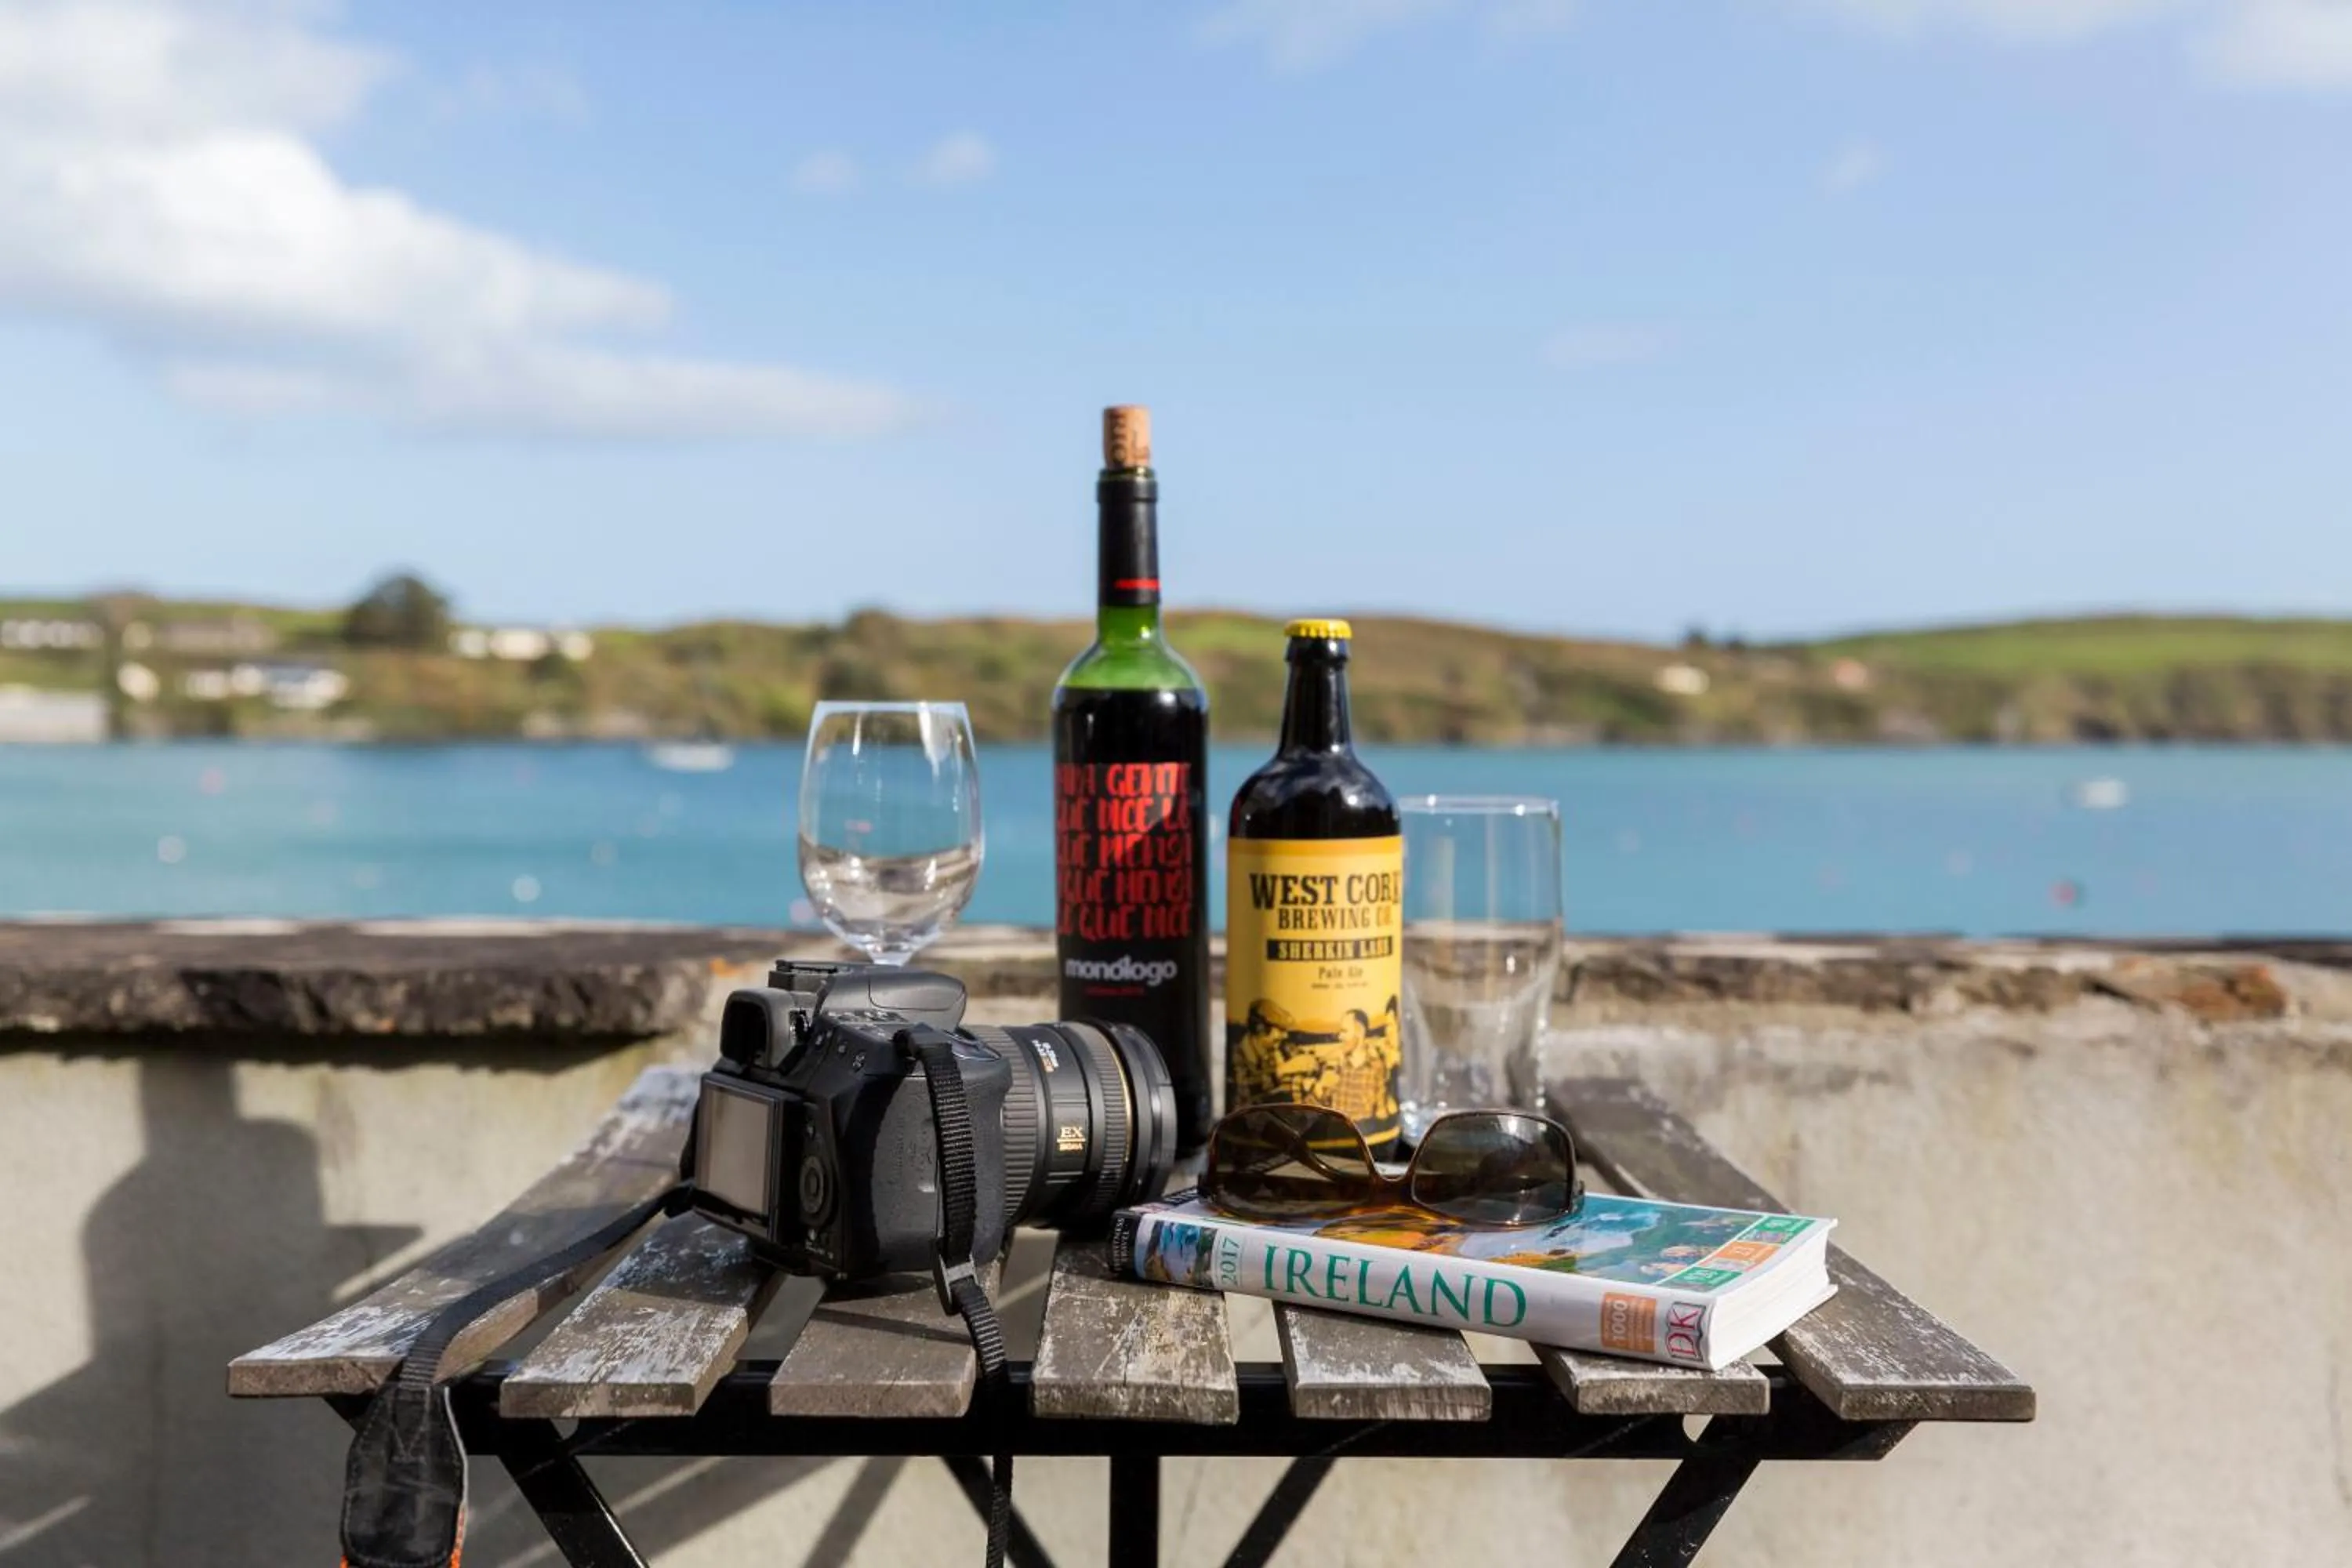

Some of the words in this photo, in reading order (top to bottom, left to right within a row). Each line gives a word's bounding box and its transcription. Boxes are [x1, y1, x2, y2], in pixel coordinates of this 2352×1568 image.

[1249, 873, 1338, 910] WEST
[1279, 907, 1370, 930] BREWING
[1061, 1126, 1083, 1138] EX
[1220, 1236, 1240, 1285] 2017
[1265, 1243, 1526, 1327] IRELAND
[1612, 1299, 1628, 1341] 1000
[1668, 1307, 1700, 1357] DK
